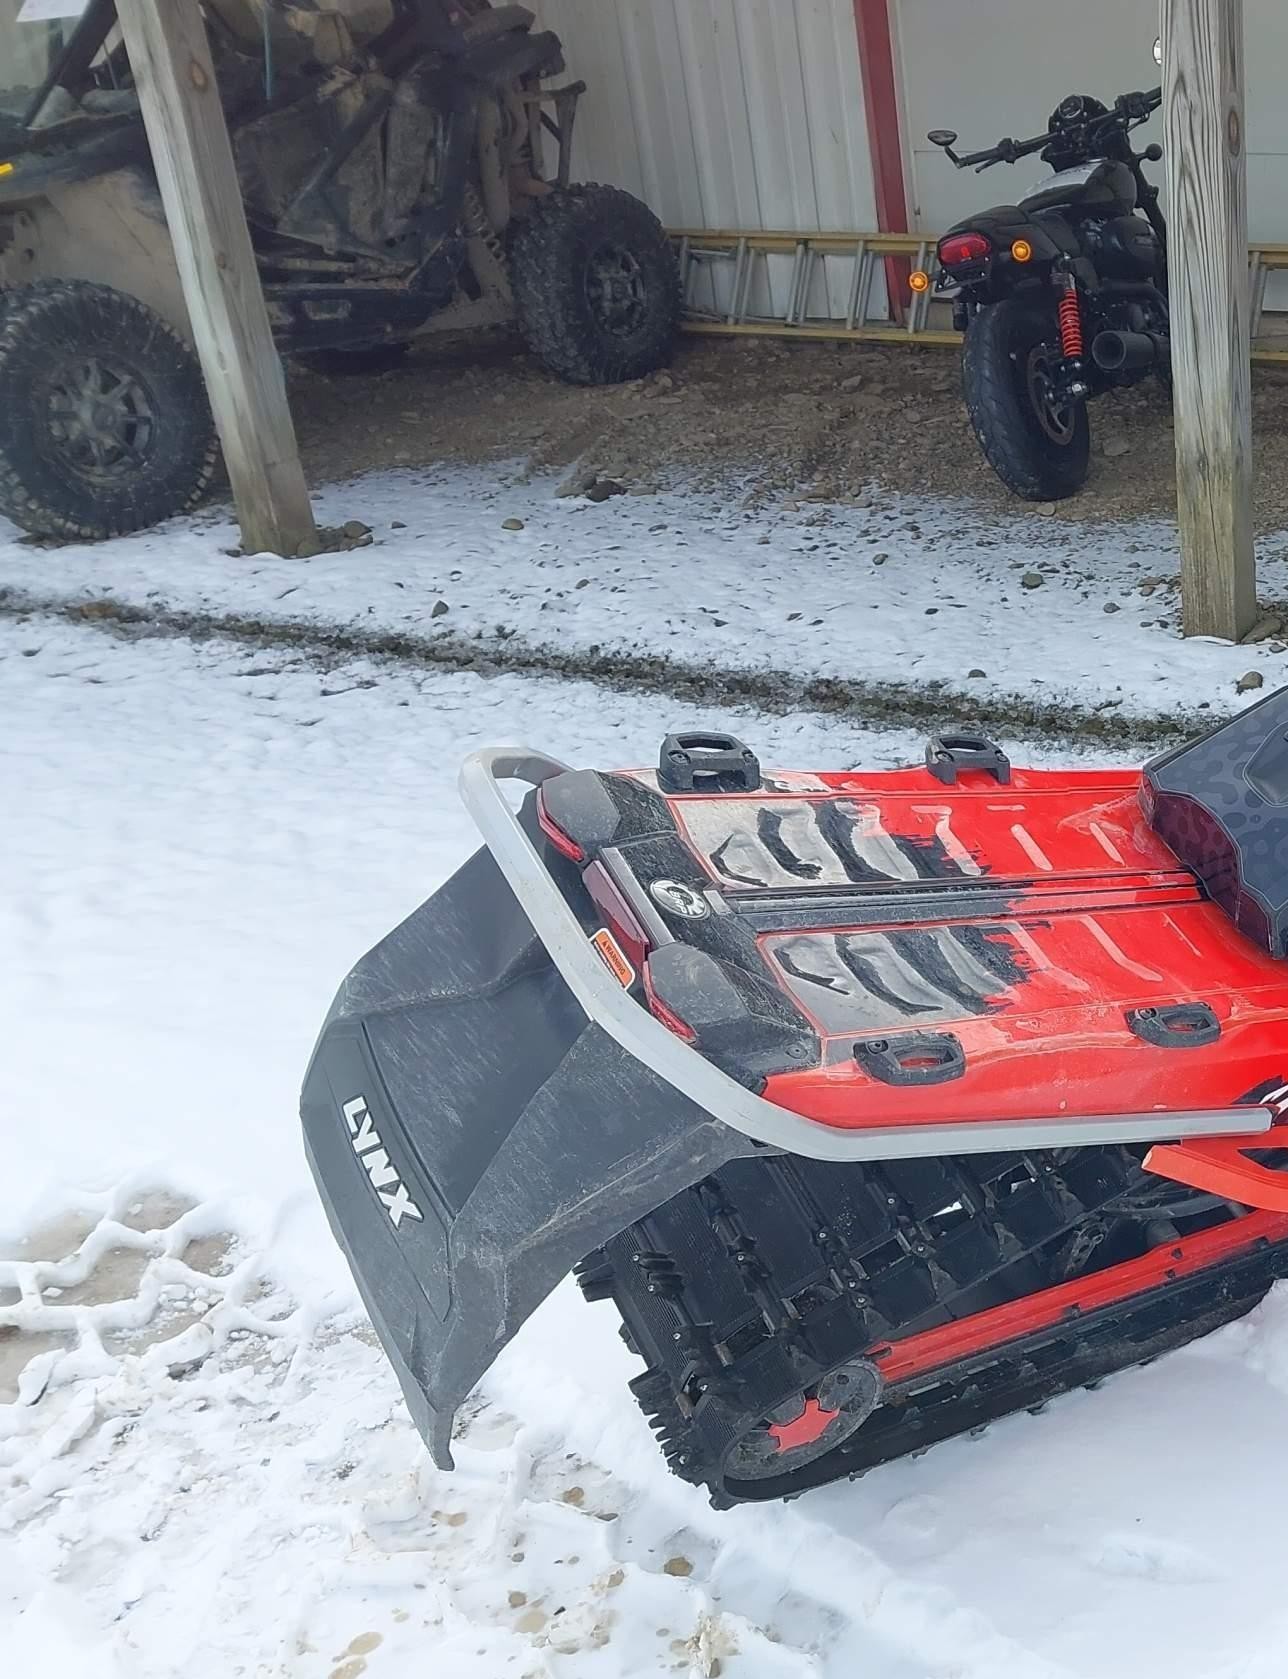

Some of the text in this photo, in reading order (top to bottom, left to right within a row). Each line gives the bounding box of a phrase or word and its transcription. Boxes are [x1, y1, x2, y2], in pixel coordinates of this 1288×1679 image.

[668, 889, 688, 914] BRP
[604, 943, 626, 976] WARNING
[342, 1095, 424, 1229] LYNX
